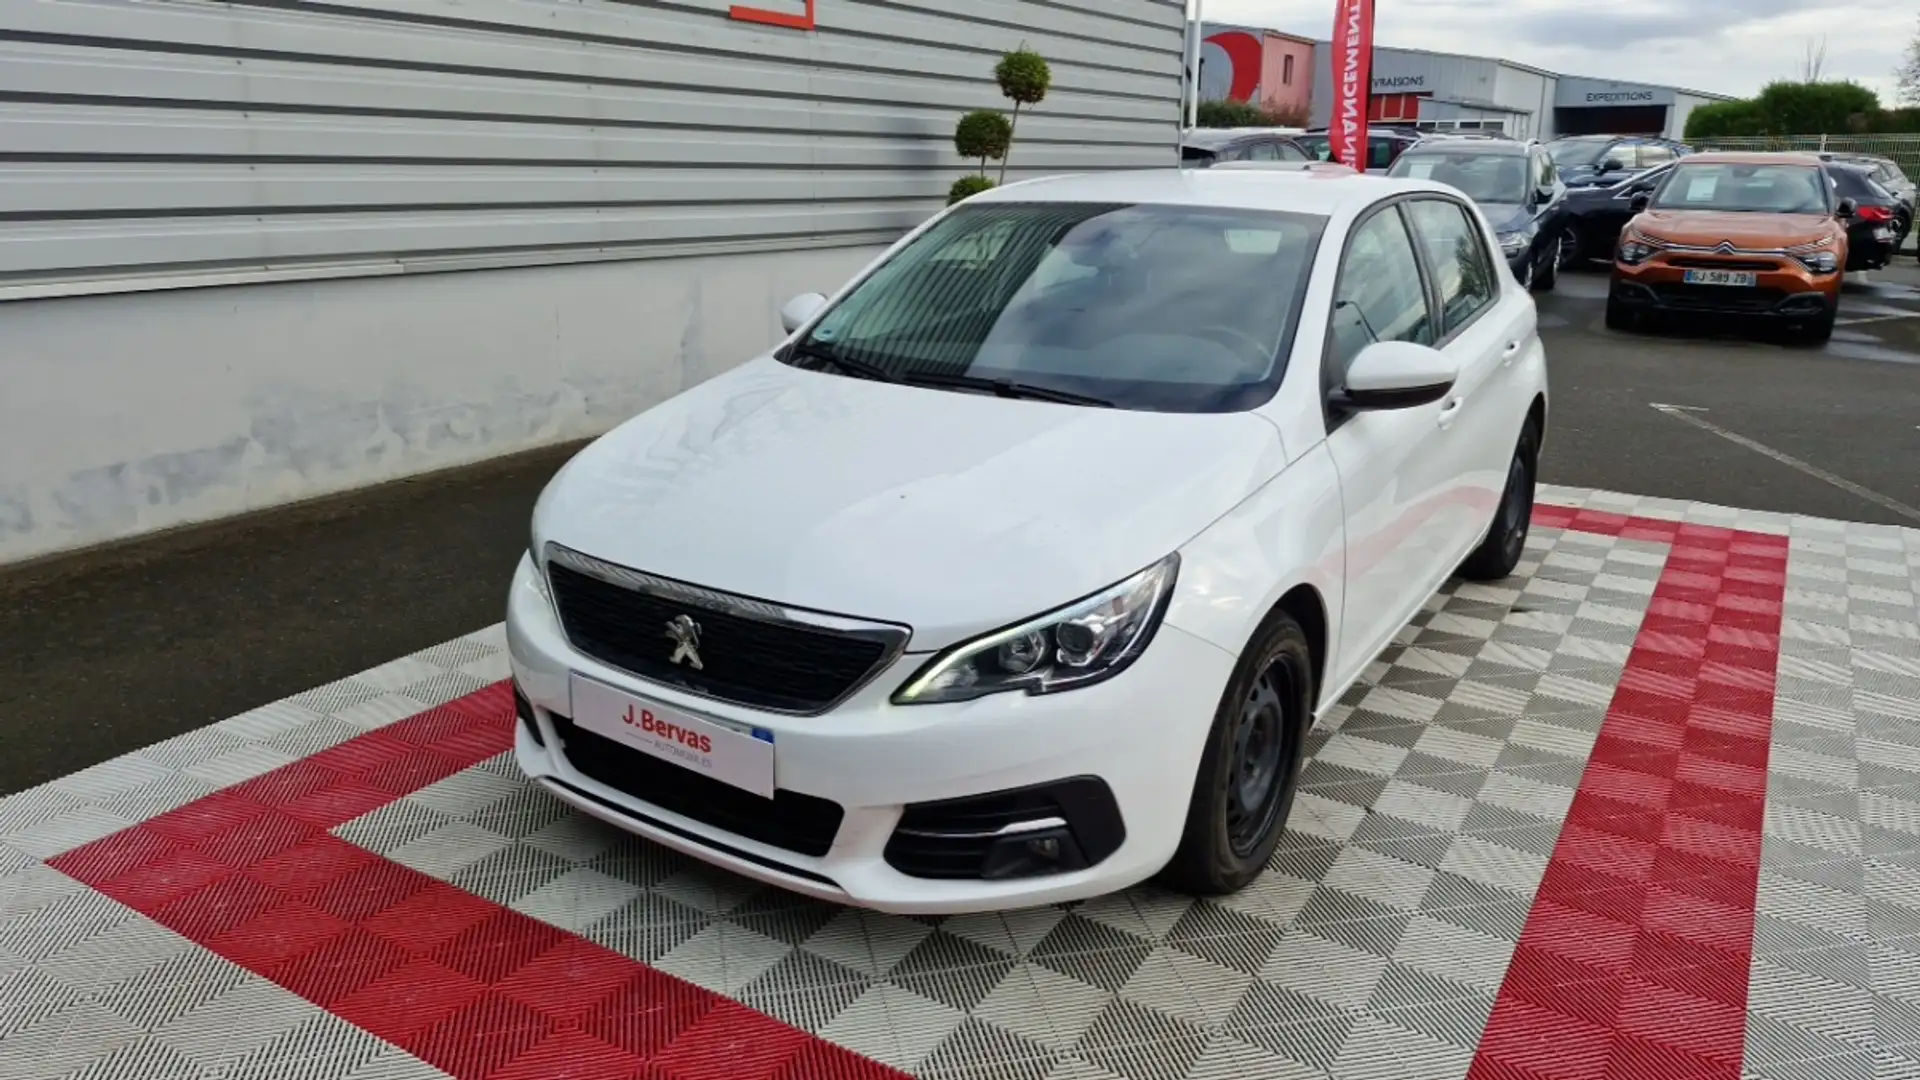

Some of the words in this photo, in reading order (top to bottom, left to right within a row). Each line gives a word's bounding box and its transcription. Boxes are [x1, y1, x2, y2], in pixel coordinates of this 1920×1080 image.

[1371, 75, 1424, 88] VRAISONS
[1586, 91, 1653, 102] EXPEDITIONS
[622, 703, 712, 753] J.Bervas
